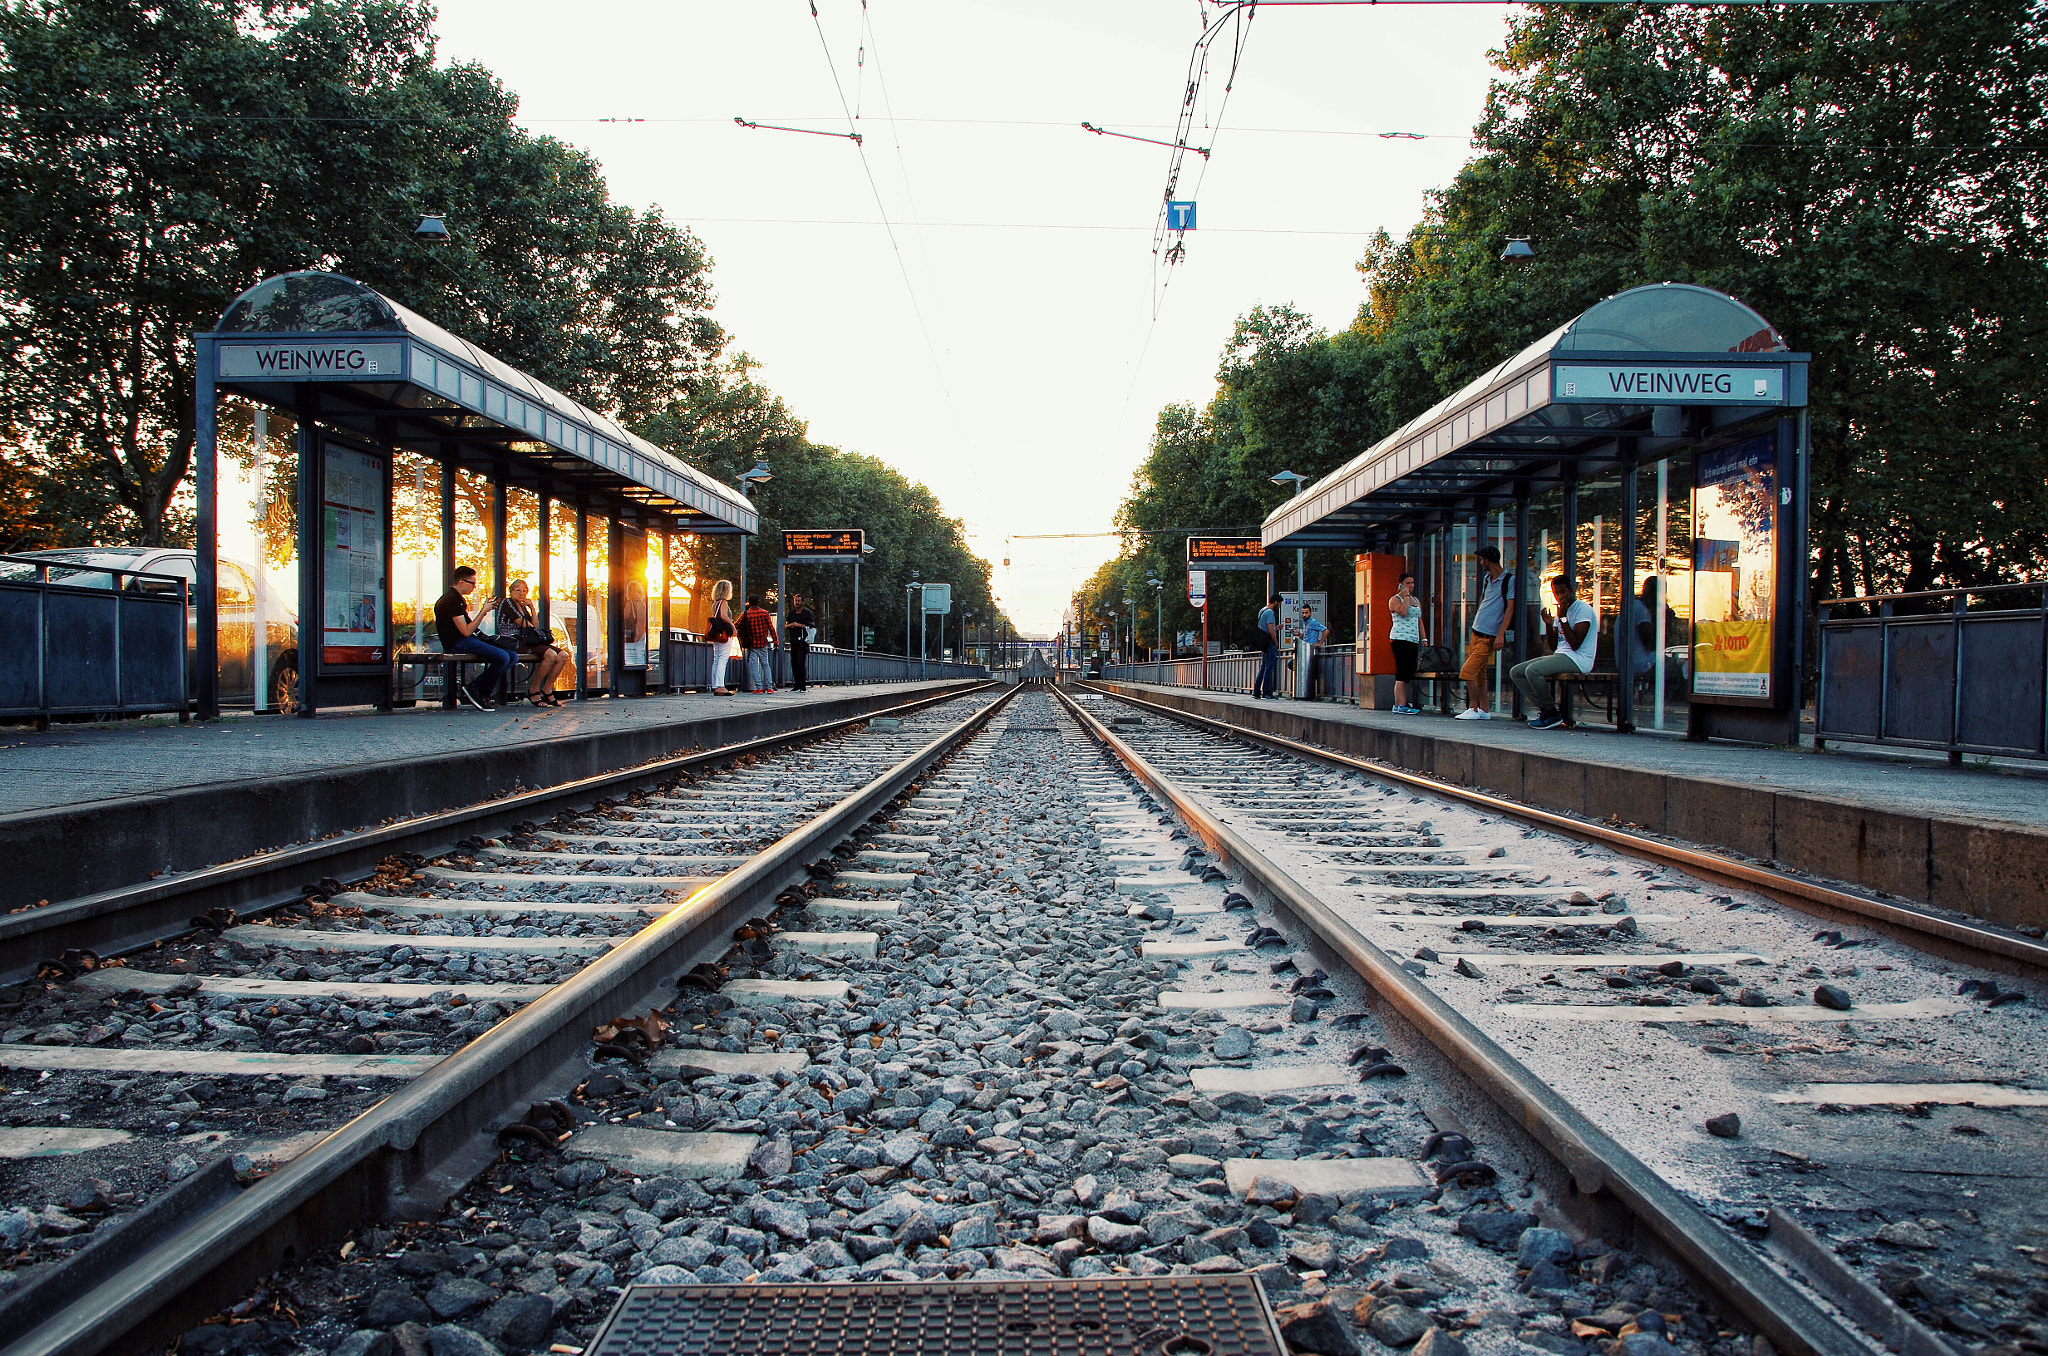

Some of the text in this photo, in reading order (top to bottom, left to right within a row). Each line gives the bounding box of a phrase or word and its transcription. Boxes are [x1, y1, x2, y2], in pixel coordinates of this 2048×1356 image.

[256, 349, 366, 370] WEINWEG
[1608, 372, 1732, 394] WEINWEG
[1724, 635, 1749, 650] LOTTO
